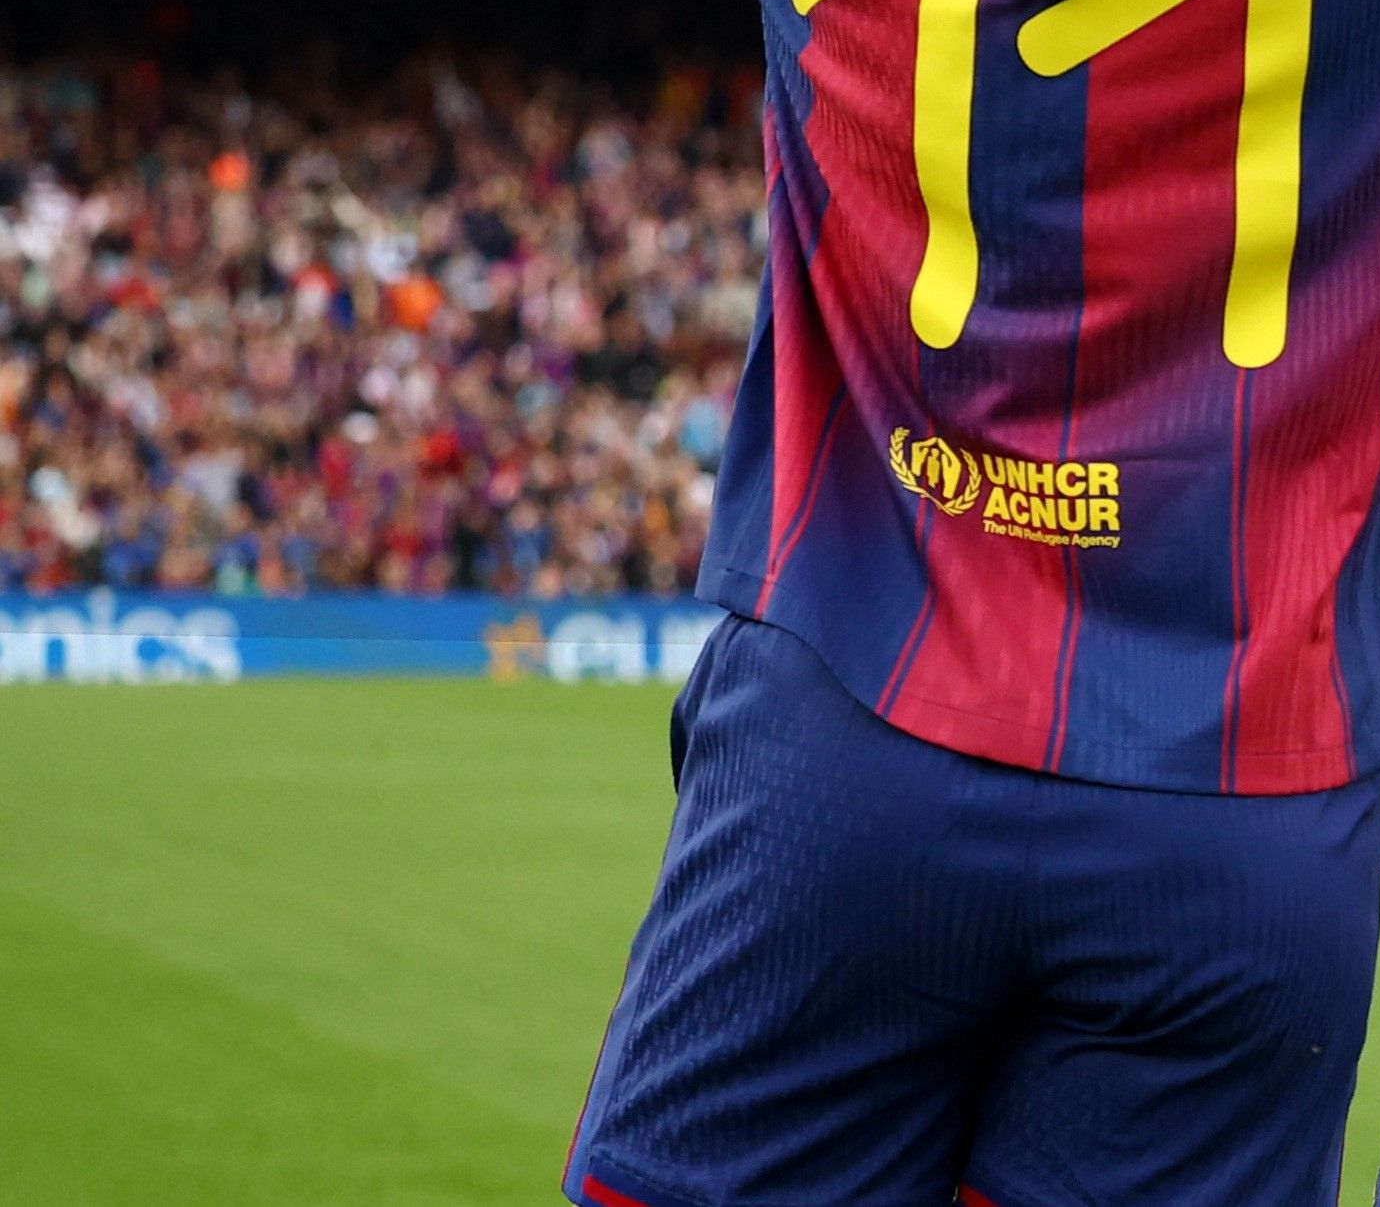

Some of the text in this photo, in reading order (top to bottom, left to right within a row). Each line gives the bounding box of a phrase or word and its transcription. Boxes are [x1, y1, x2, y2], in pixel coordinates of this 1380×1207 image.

[983, 453, 1120, 496] UNHCR
[983, 486, 1120, 531] ACNUR
[983, 519, 1006, 535] The
[1071, 533, 1120, 549] Agency
